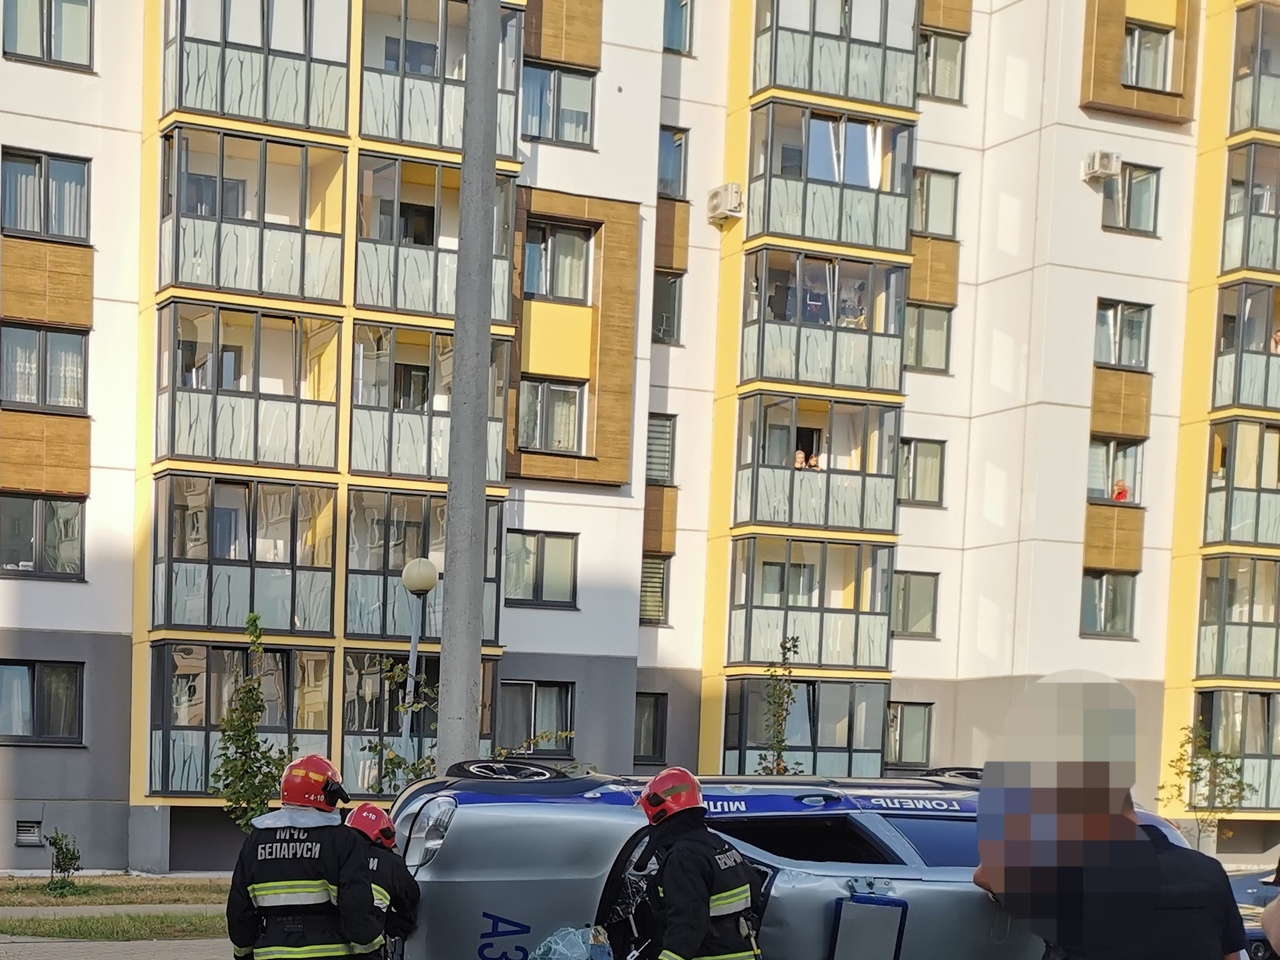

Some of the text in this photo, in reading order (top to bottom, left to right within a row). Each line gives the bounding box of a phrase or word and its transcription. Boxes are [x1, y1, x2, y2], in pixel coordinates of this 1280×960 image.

[871, 797, 961, 811] ГОМЕЛЬ
[275, 828, 308, 840] МЧС
[257, 842, 321, 861] БЕЛАРУСИ
